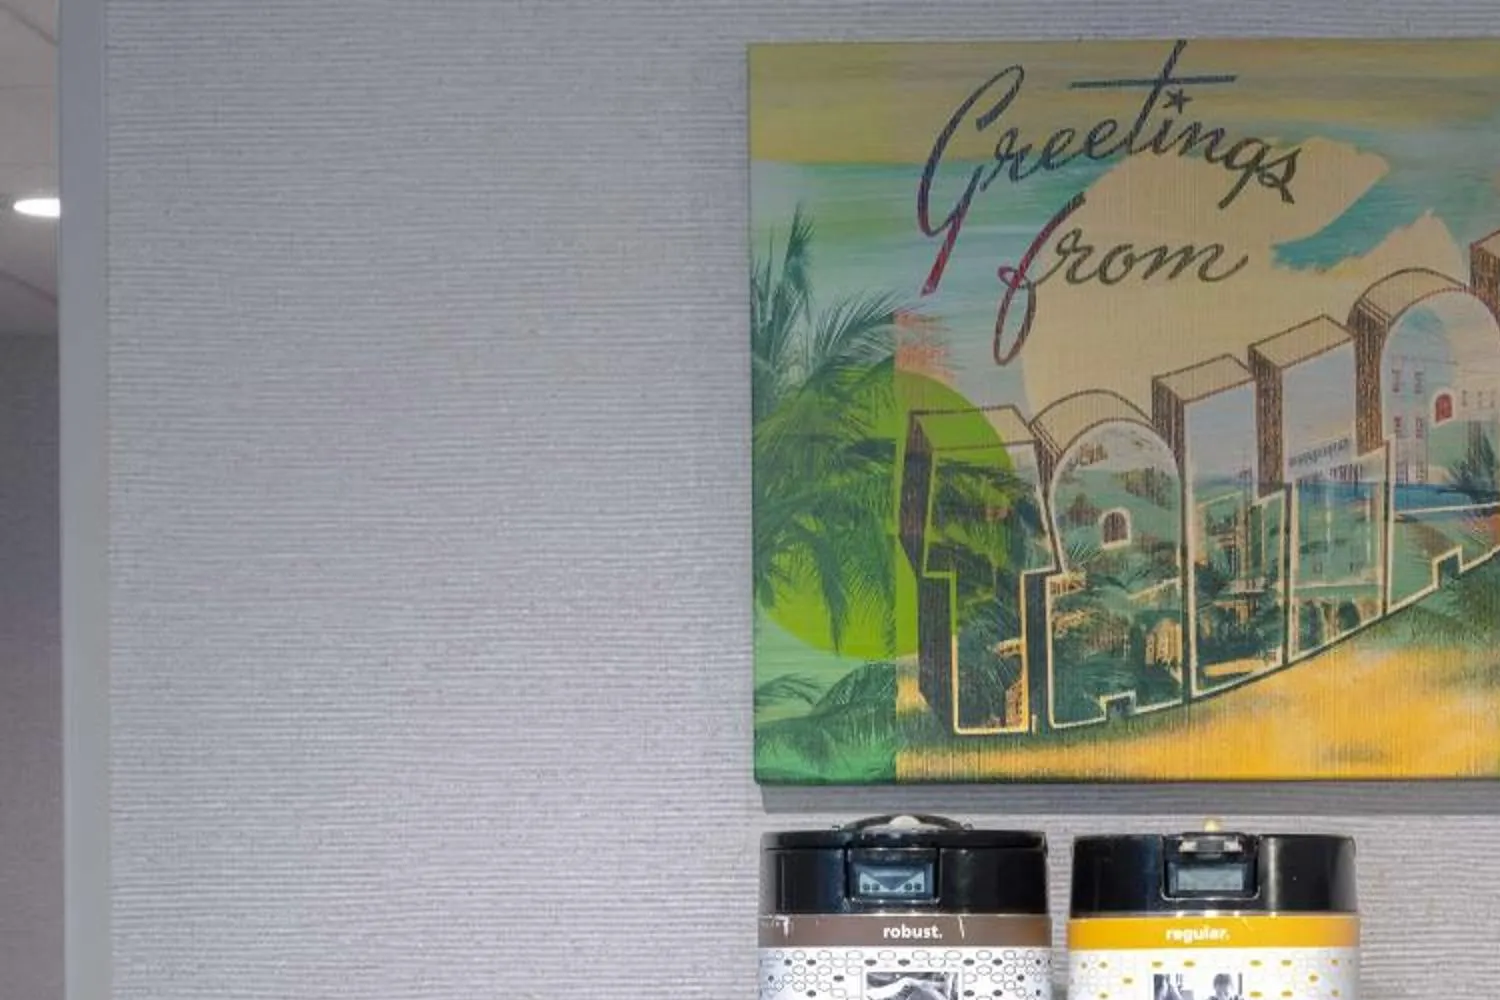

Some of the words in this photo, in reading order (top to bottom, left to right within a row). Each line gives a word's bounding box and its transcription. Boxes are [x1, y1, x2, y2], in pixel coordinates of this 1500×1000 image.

[916, 40, 1302, 297] Greetings
[993, 191, 1249, 366] from
[882, 923, 942, 939] robust.
[1165, 925, 1231, 943] regular.
